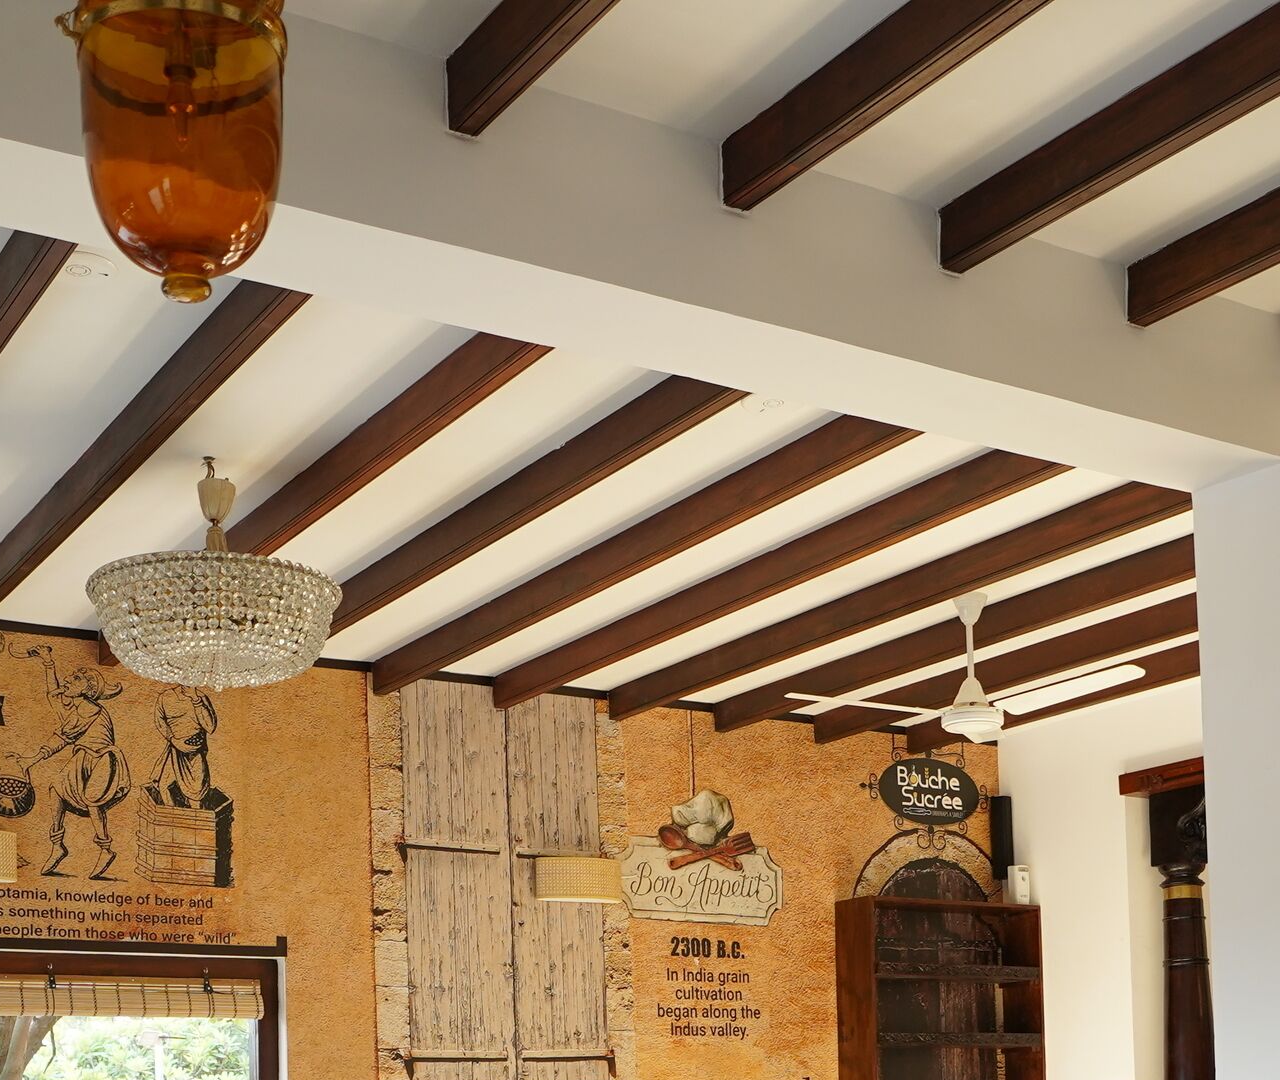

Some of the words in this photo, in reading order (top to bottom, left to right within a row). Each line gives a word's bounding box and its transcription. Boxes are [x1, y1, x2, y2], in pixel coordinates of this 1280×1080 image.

[896, 764, 960, 791] Bouche
[901, 785, 963, 811] Sucrée
[630, 861, 683, 899] Bon
[55, 889, 132, 907] knowledge
[136, 893, 151, 906] of
[155, 894, 185, 908] beer
[188, 897, 213, 909] and
[8, 906, 86, 923] something
[90, 909, 131, 923] which
[135, 913, 203, 926] separated
[47, 924, 81, 939] from
[85, 927, 125, 940] those
[128, 928, 158, 942] who
[161, 932, 195, 943] were
[670, 936, 711, 958] 2300
[716, 939, 745, 959] B.C.
[666, 967, 679, 981] In
[683, 968, 714, 983] India
[718, 970, 750, 986] grain
[675, 986, 743, 1001] cultivation
[657, 1003, 698, 1022] began
[701, 1004, 737, 1022] along
[741, 1005, 761, 1019] the
[671, 1022, 707, 1037] Indus
[710, 1022, 749, 1040] valley.
